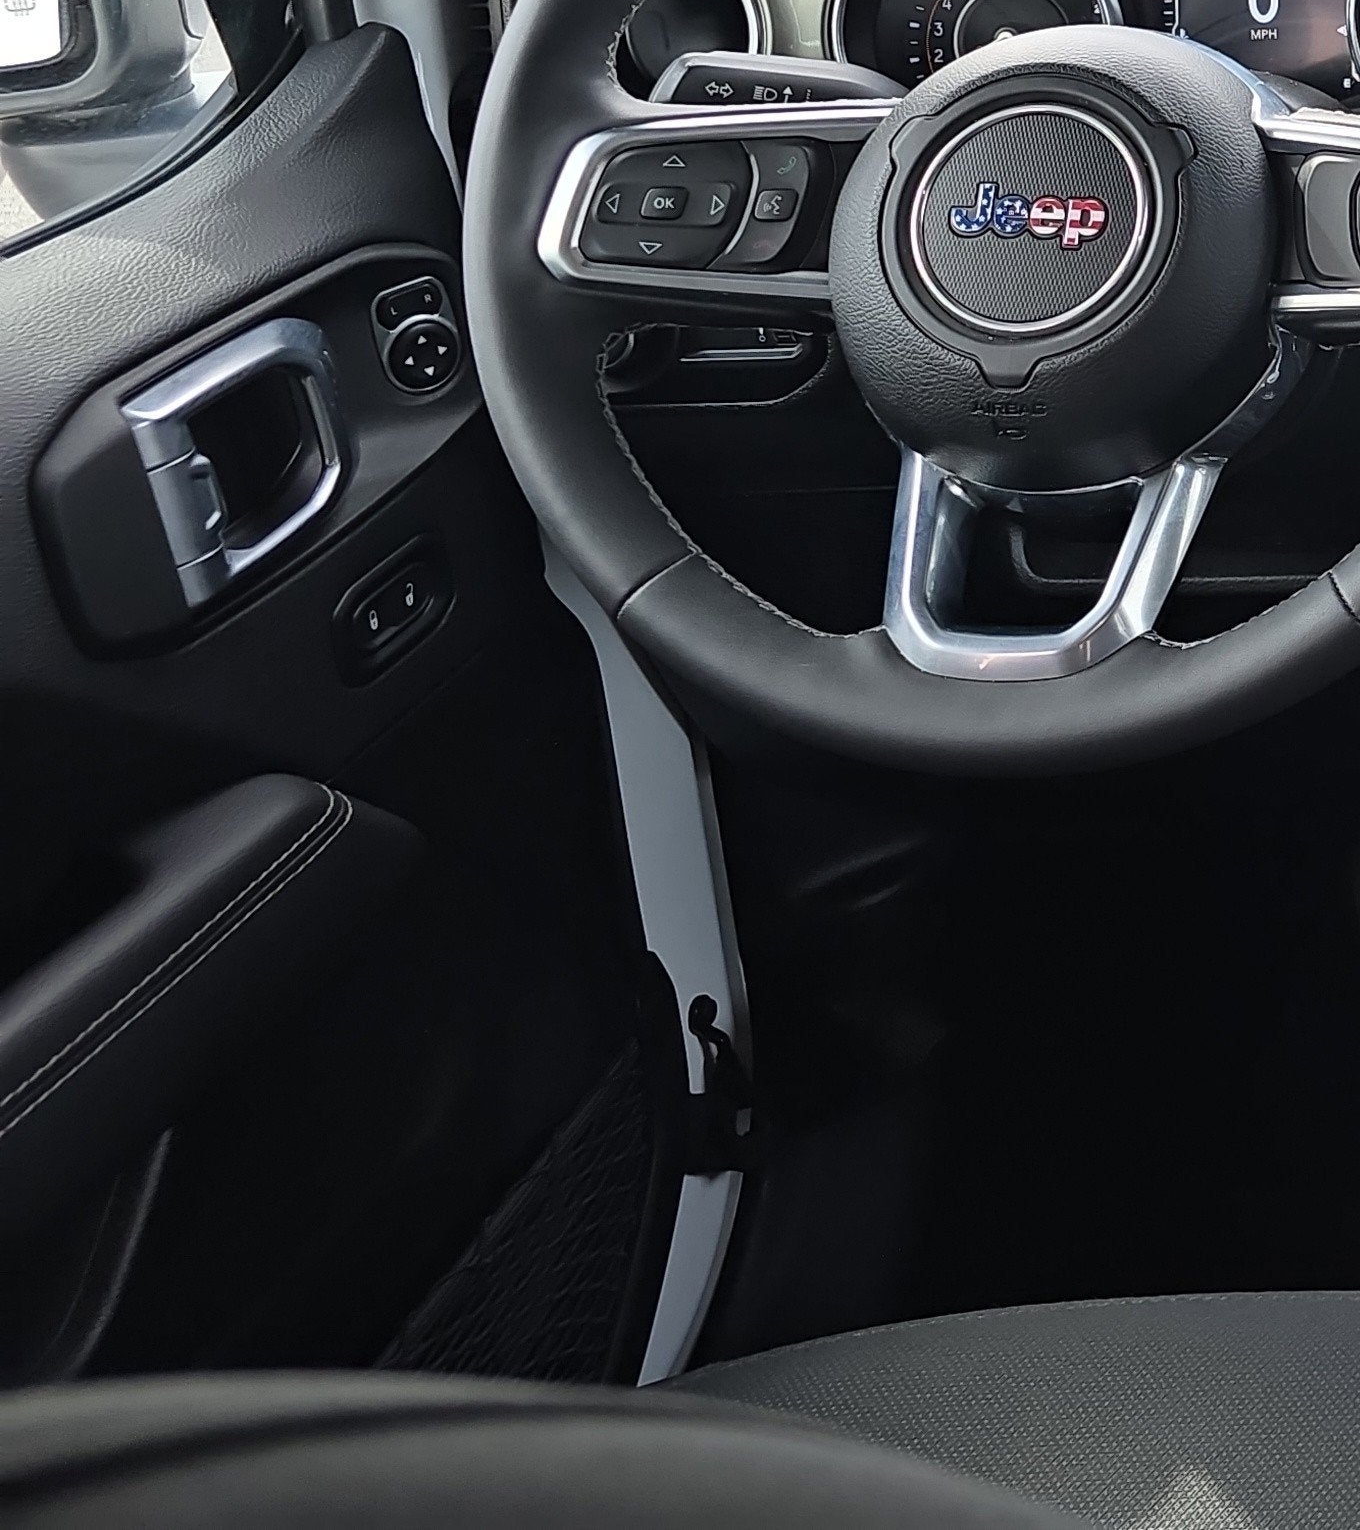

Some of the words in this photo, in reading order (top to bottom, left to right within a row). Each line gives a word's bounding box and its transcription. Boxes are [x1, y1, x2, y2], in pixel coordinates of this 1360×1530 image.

[934, 22, 943, 36] 3
[1250, 29, 1278, 40] MPH
[934, 49, 944, 63] 2
[653, 196, 675, 210] OK
[950, 183, 1106, 246] Jeep
[424, 294, 432, 304] R
[390, 307, 398, 315] L
